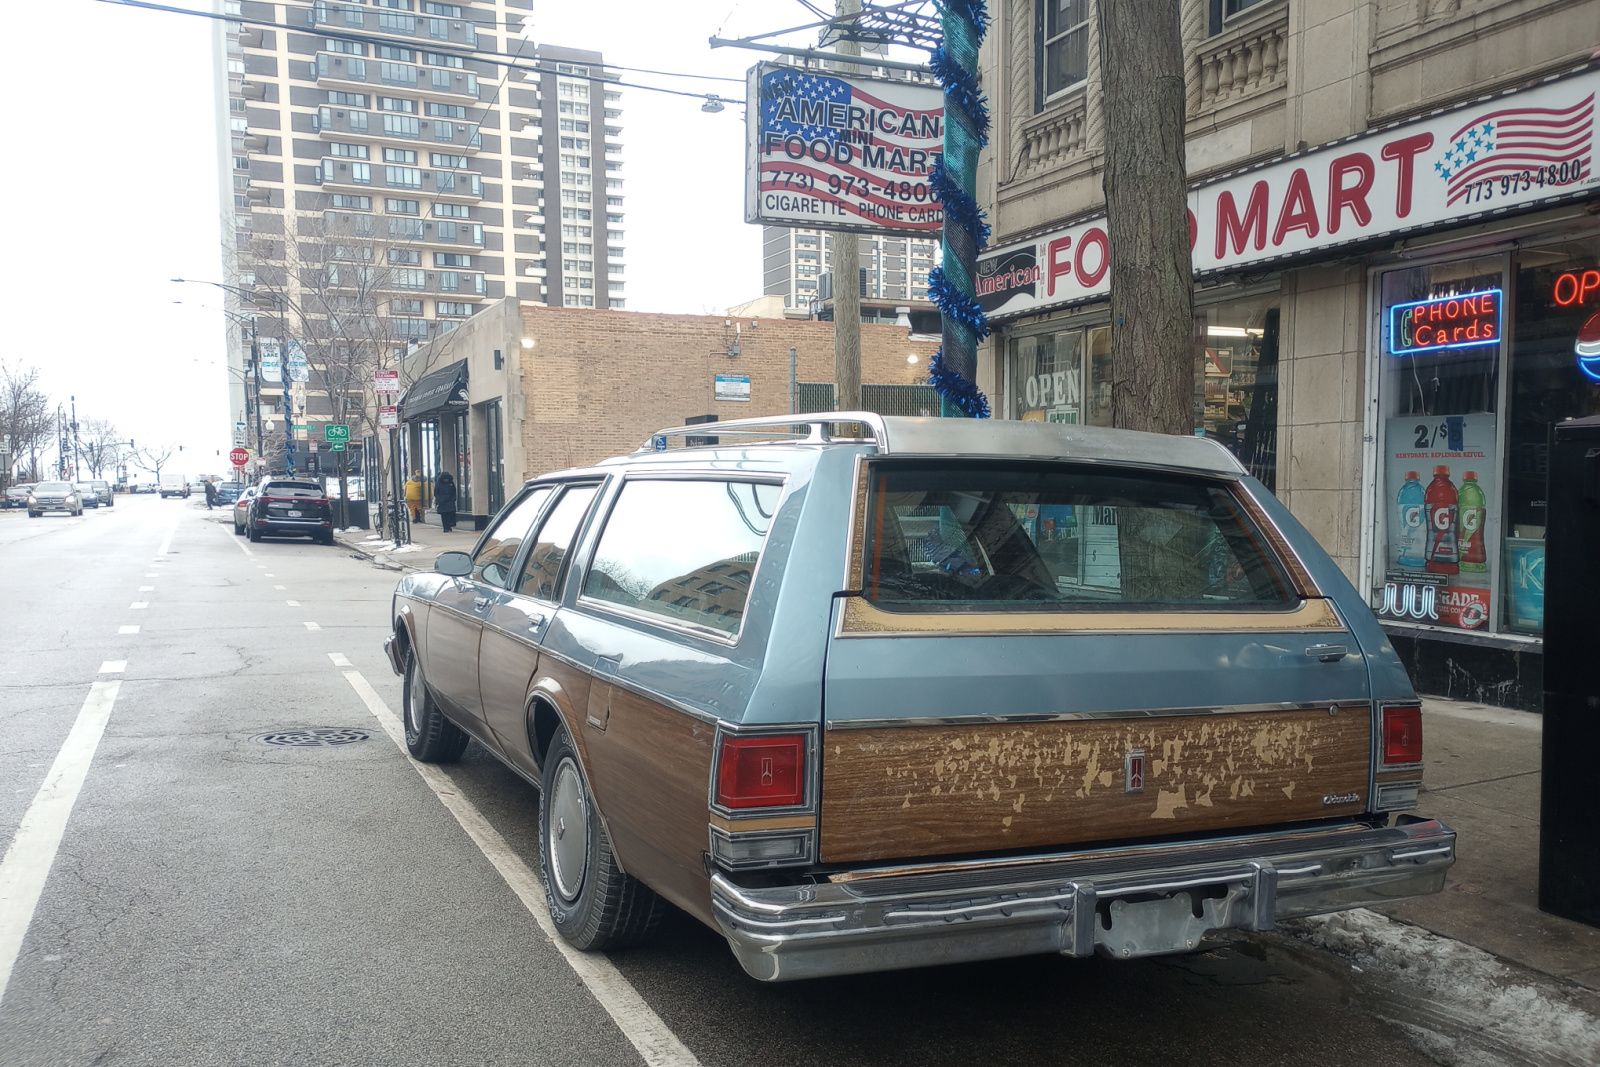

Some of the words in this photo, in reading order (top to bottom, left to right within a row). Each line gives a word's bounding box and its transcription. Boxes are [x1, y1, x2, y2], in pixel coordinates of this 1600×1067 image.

[776, 97, 940, 139] AMERICAN
[765, 131, 853, 165] FOOD
[839, 130, 874, 146] MINI
[769, 170, 815, 192] 773)
[1465, 179, 1493, 204] 773
[1501, 170, 1531, 195] 973
[1535, 158, 1580, 188] 4800
[765, 194, 847, 216] CIGARETTE
[859, 202, 904, 221] PHONE
[1215, 132, 1434, 260] MART
[980, 258, 998, 275] NEW
[1413, 294, 1494, 324] PHONE
[1415, 319, 1494, 346] Cards
[1026, 369, 1080, 408] OPEN
[230, 452, 249, 461] STOP
[1434, 507, 1450, 530] G
[1379, 583, 1439, 620] JUUL
